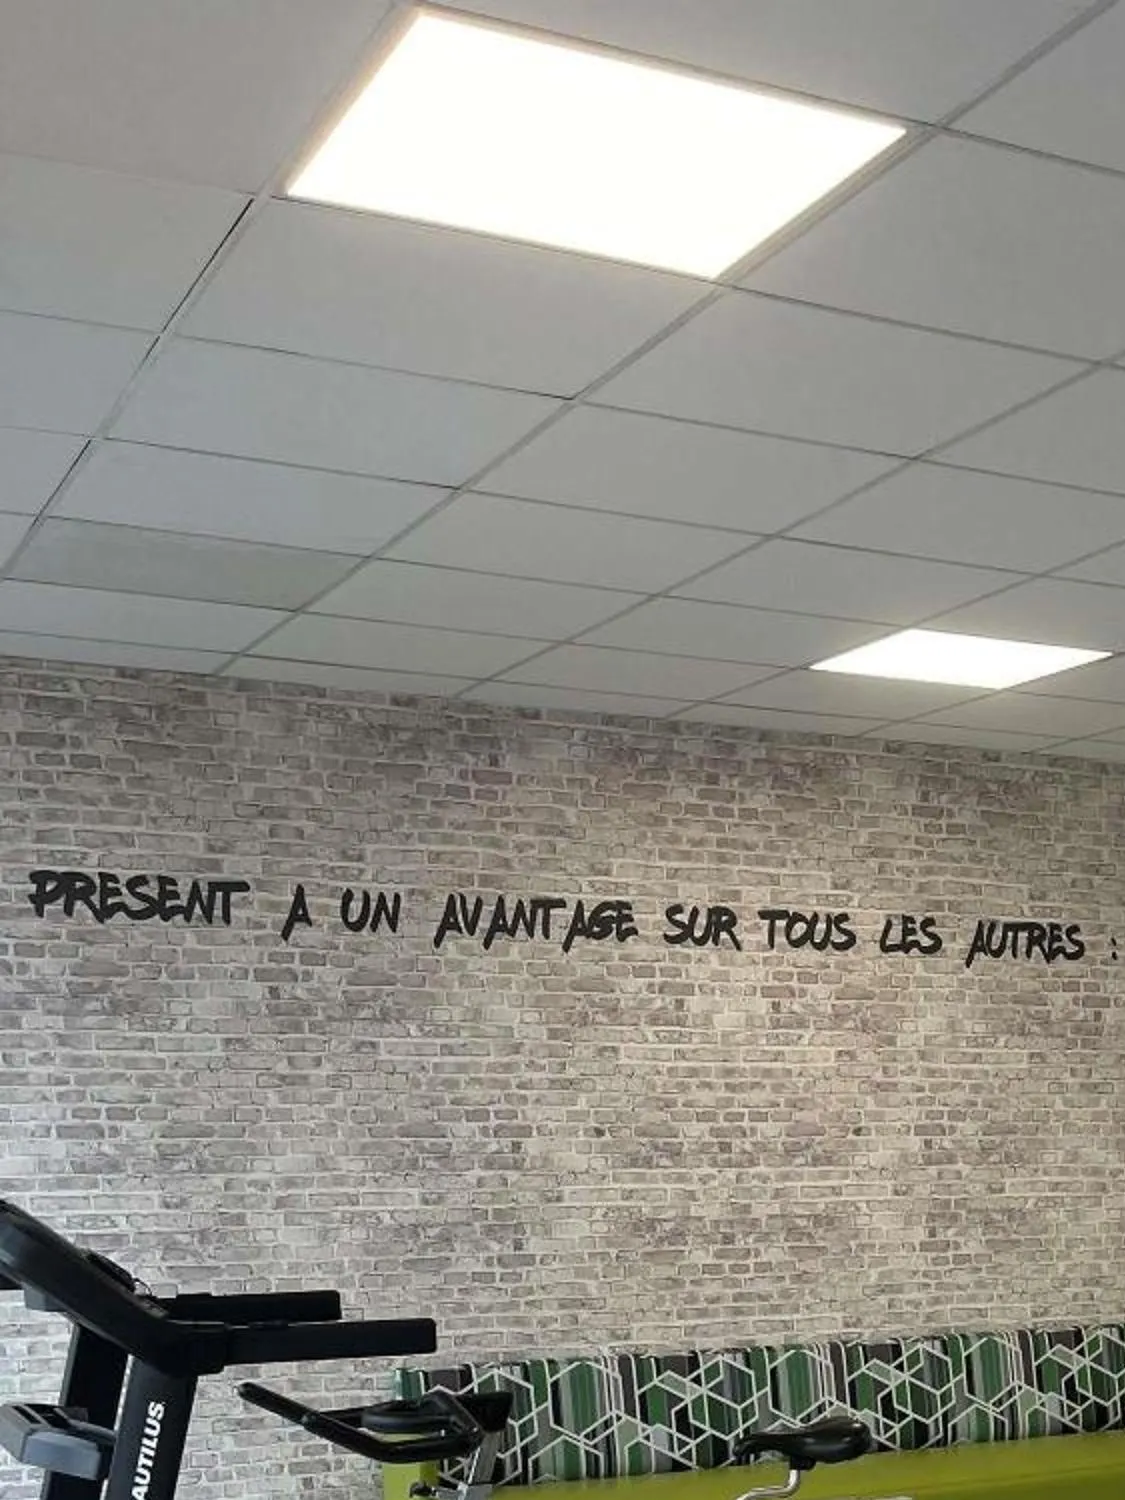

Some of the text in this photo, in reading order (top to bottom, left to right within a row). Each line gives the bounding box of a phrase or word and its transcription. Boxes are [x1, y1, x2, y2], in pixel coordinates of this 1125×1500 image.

[27, 869, 251, 926] PRESENT
[280, 883, 313, 942] A
[339, 887, 401, 934] UN
[433, 892, 639, 954] AVANTAGE
[663, 903, 742, 951] SUR
[757, 909, 857, 952] TOUS
[879, 914, 943, 955] LES
[965, 919, 1086, 969] AUTRES
